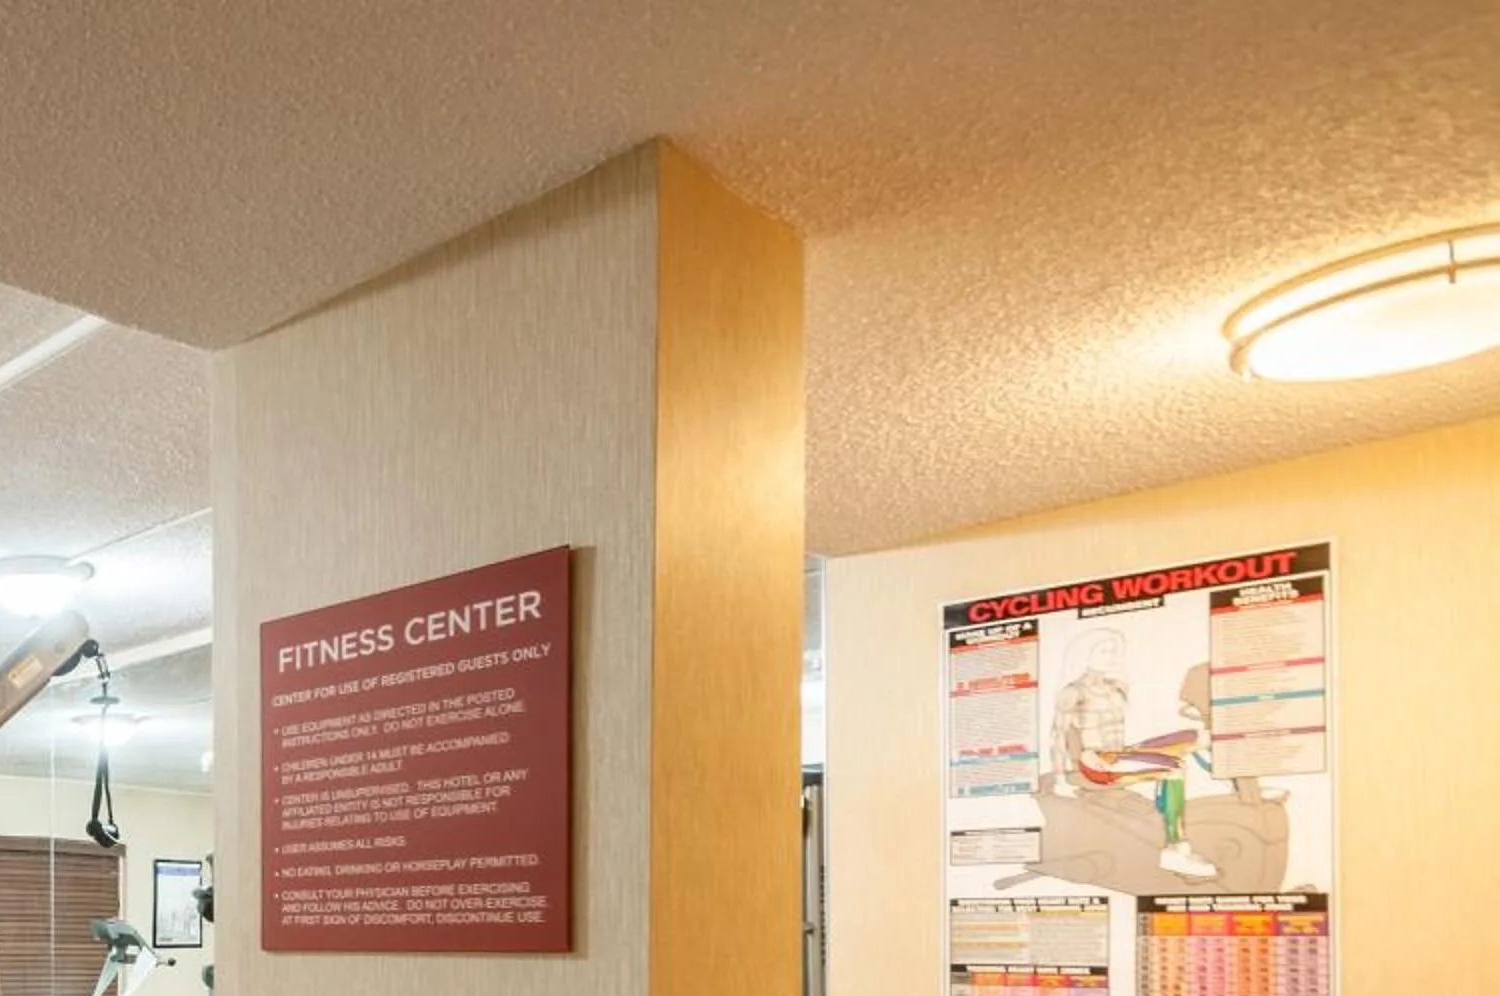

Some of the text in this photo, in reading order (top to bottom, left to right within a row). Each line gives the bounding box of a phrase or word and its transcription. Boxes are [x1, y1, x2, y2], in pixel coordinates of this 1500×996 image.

[968, 551, 1297, 625] CYCLING WORKOUT
[278, 589, 541, 673] FITNESS CENTER
[273, 641, 550, 708] CENTER FOR USE OF REGISTERED GUESTS ONLY
[373, 701, 426, 721] DIRECTED
[428, 699, 439, 712] IN
[442, 694, 464, 710] THE
[467, 685, 515, 706] POSTED
[383, 719, 399, 733] DO
[401, 715, 423, 730] NOT
[425, 706, 483, 727] EXERCISE
[329, 752, 362, 767] UNDER
[366, 749, 377, 762] 14
[410, 743, 425, 756] BE
[426, 730, 510, 754] ACCOMPANIED
[416, 777, 441, 791] THIS
[443, 772, 482, 788] HOTEL
[483, 770, 501, 784] OR
[502, 766, 528, 782] ANY
[405, 785, 483, 806] RESPONSIBLE
[485, 782, 511, 798] FOR
[373, 810, 387, 823] TO
[413, 805, 429, 819] OF
[356, 837, 372, 849] ALL
[384, 861, 400, 873] OR
[402, 856, 468, 872] HORSEPLAY
[355, 885, 408, 898] PHYSICIAN
[411, 882, 455, 896] BEFORE
[405, 898, 422, 910] DO
[424, 897, 448, 910] NOT
[347, 913, 360, 925] OF
[435, 909, 514, 923] DISCONTINUE
